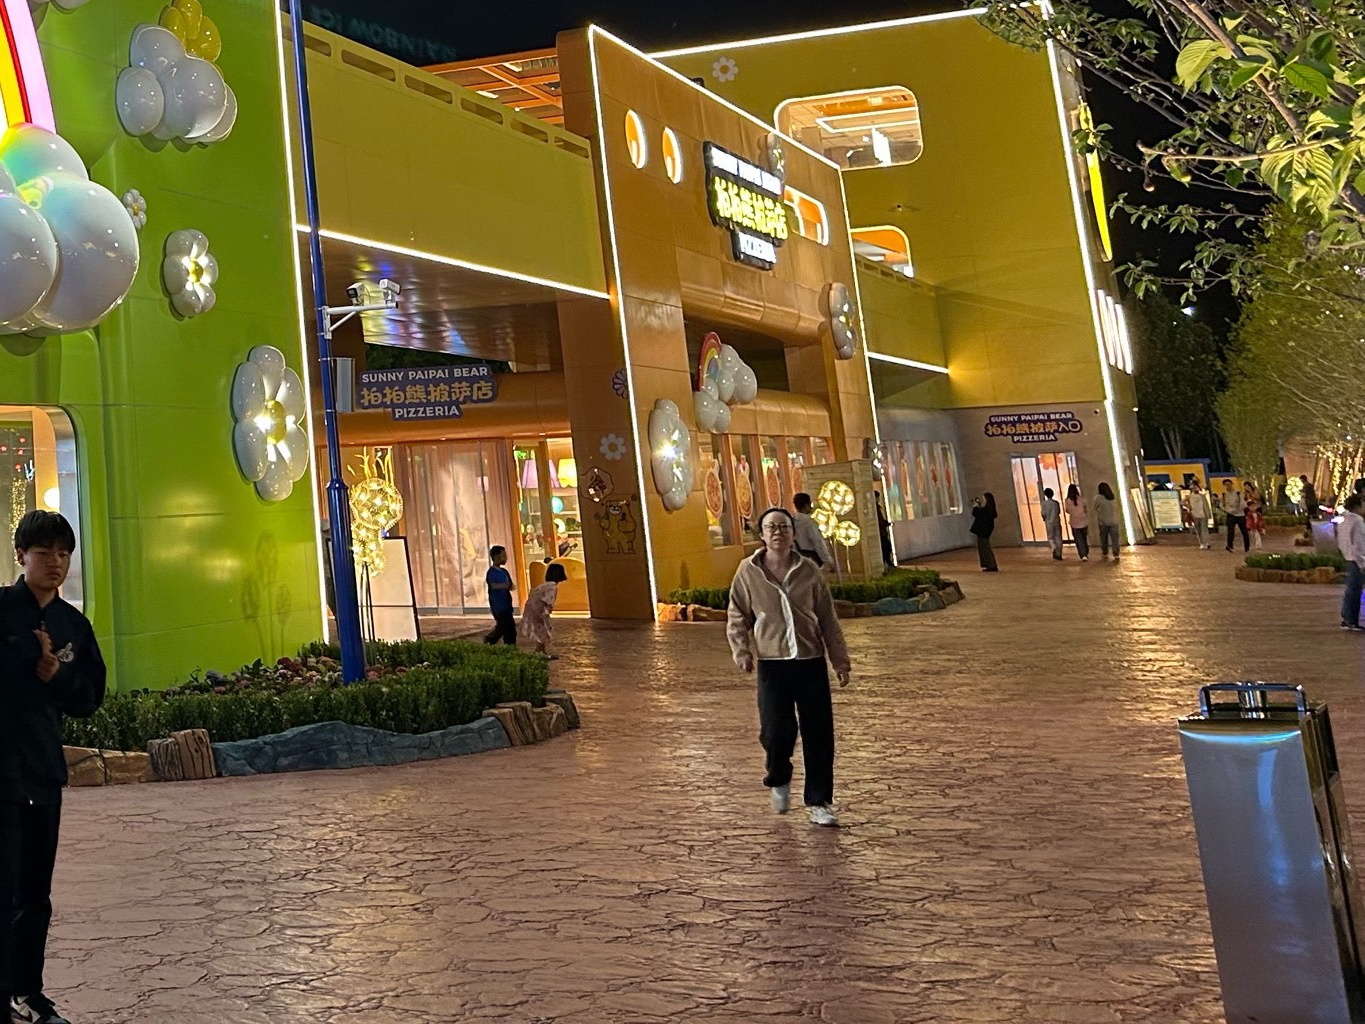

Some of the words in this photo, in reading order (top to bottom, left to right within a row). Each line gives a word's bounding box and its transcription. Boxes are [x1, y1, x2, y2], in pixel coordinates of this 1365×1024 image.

[362, 371, 404, 383] SUNNY
[408, 369, 449, 380] PAIPAI
[454, 367, 488, 377] BEAR
[360, 380, 493, 406] 拍拍熊披萨店
[395, 405, 460, 418] PIZZERIA
[1013, 434, 1056, 442] PIZZERIA
